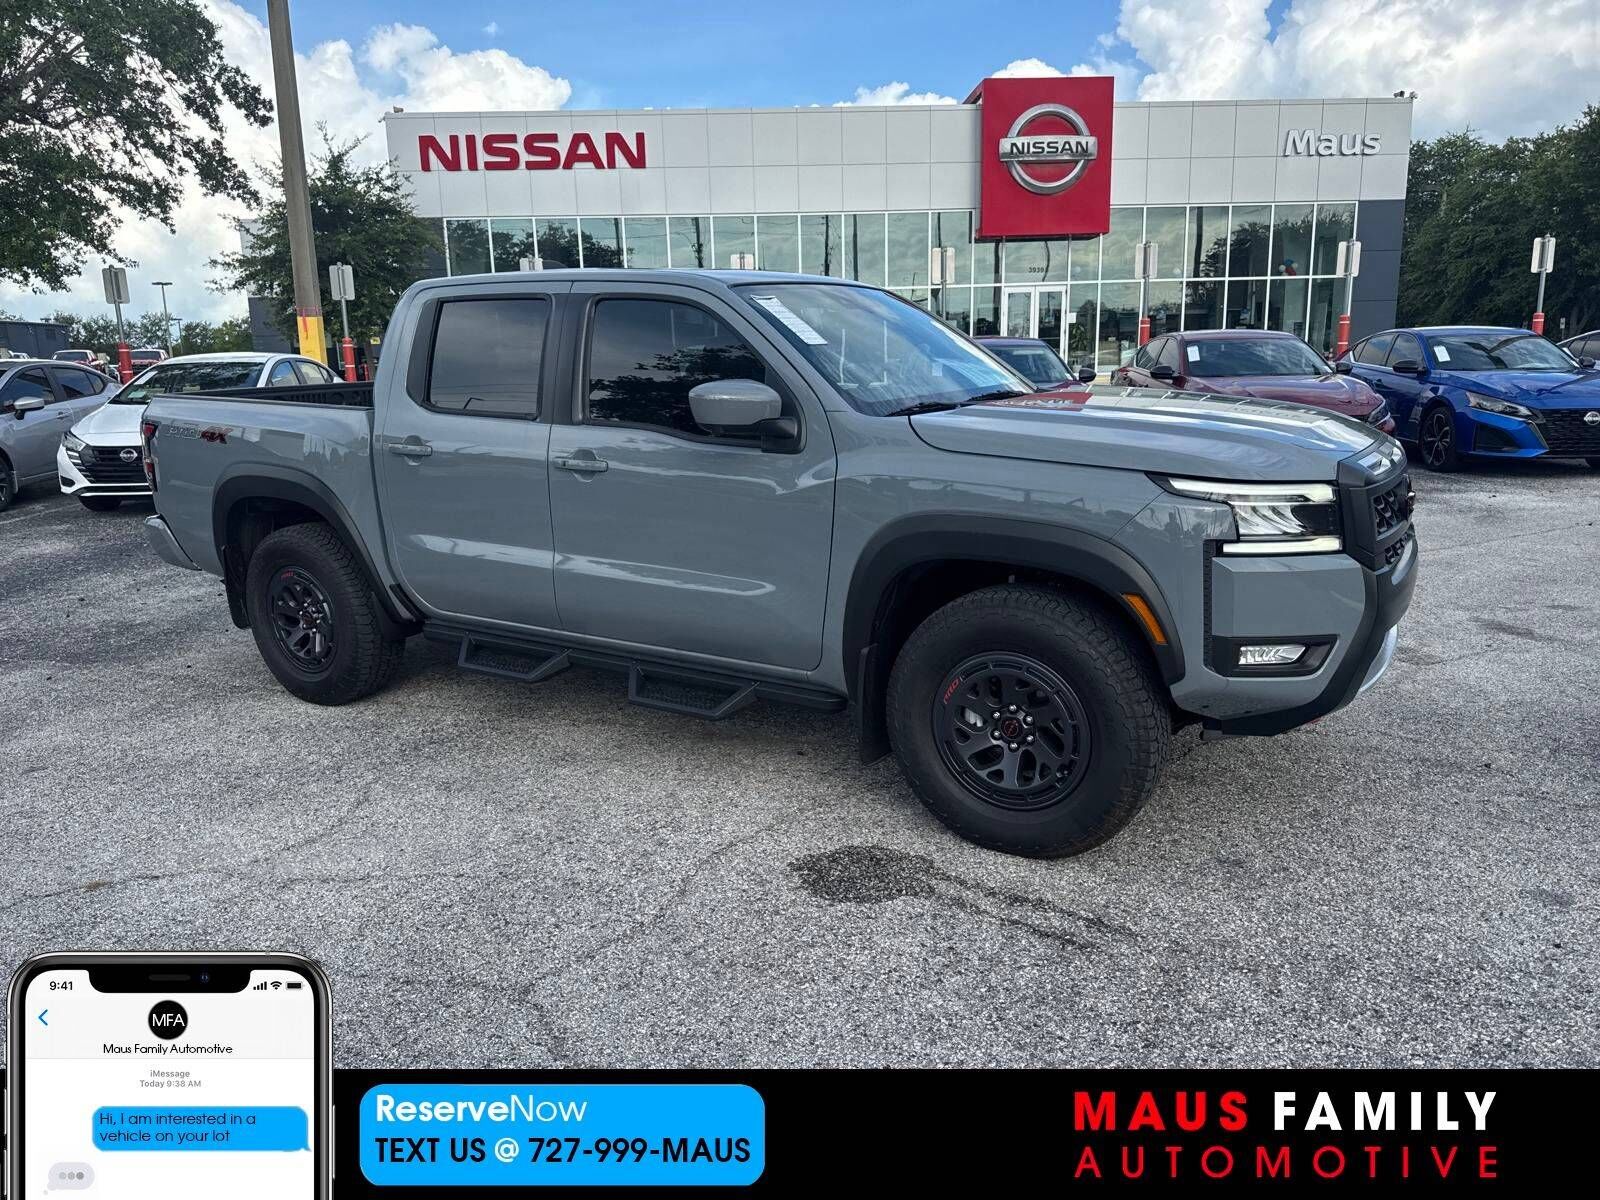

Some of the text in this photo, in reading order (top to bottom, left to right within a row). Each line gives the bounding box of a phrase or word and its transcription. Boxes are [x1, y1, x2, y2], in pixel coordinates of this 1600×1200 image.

[418, 132, 647, 172] NISSAN
[1009, 140, 1090, 155] NISSAN
[1283, 128, 1382, 158] Maus
